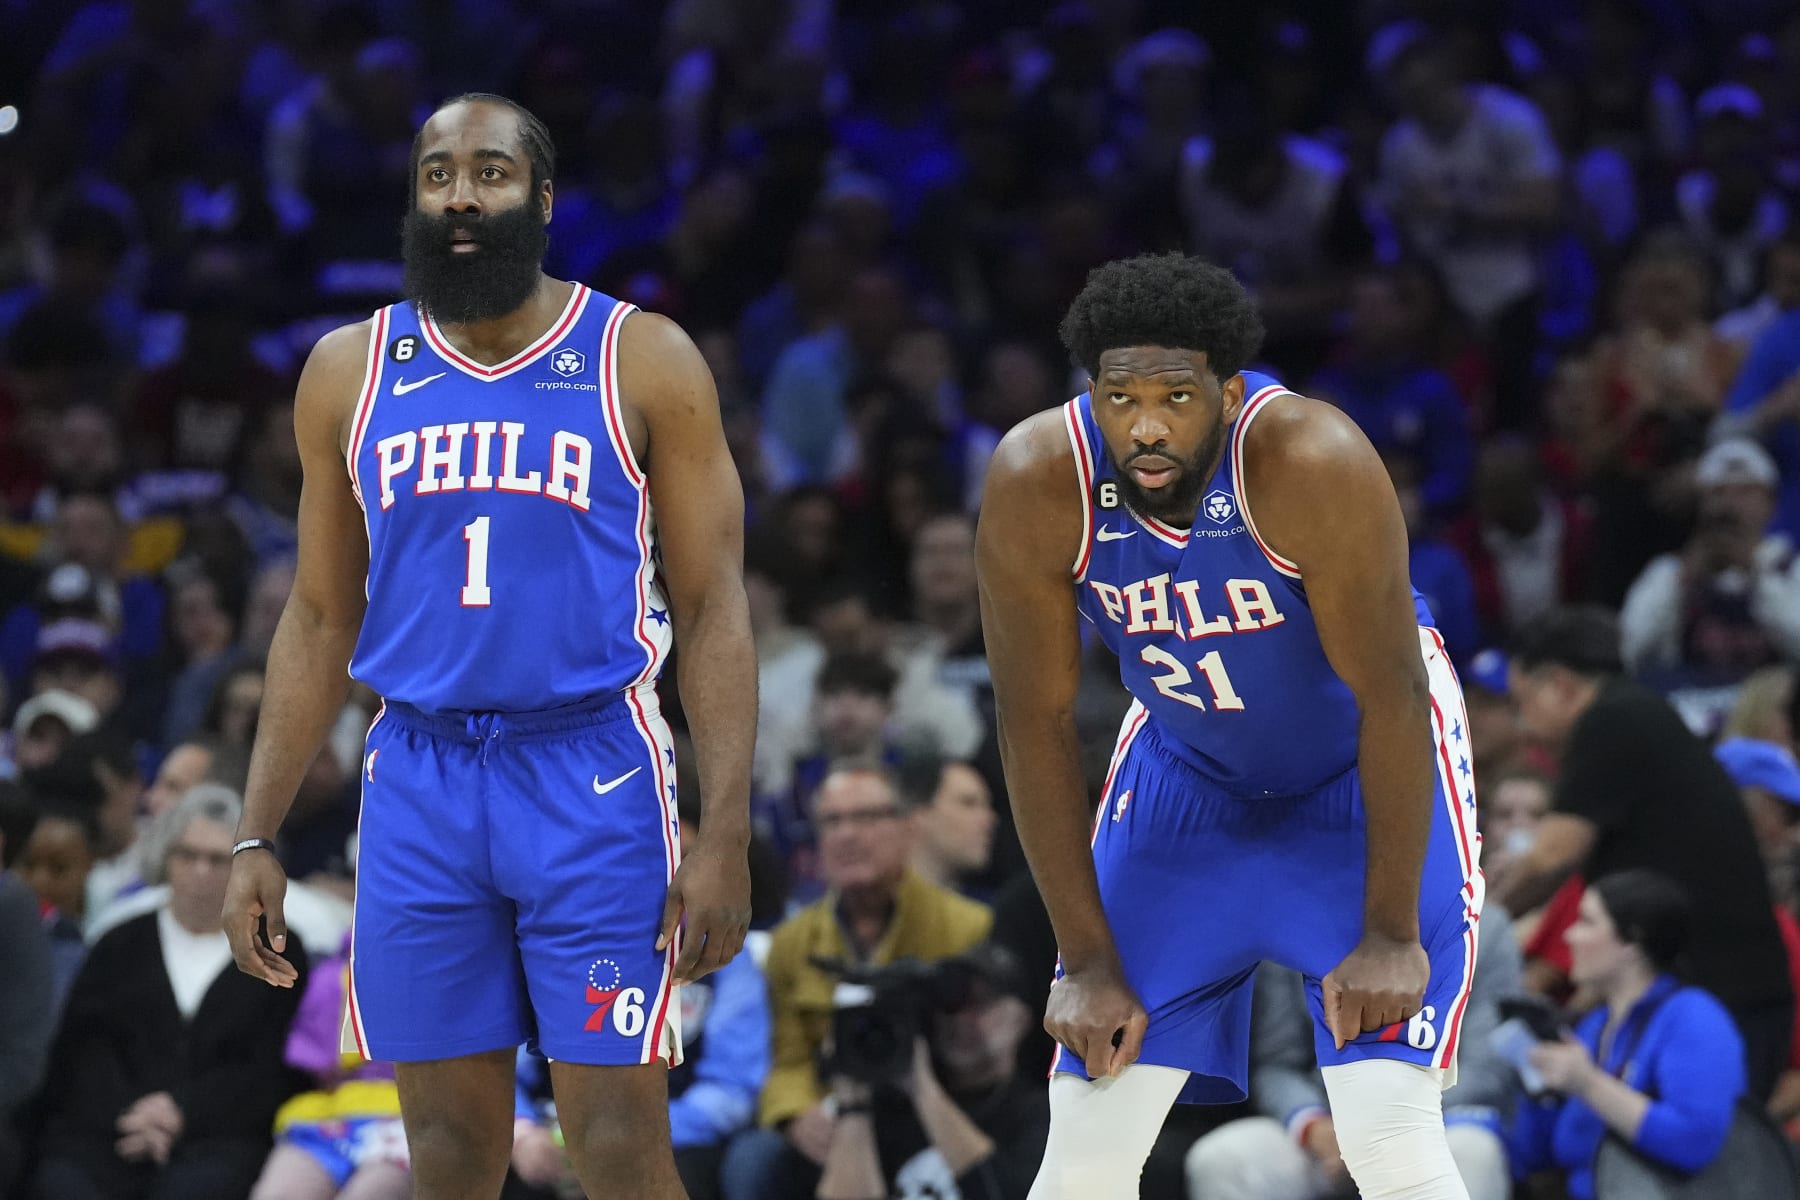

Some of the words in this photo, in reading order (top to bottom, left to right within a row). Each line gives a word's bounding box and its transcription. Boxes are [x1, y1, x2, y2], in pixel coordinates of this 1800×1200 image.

[396, 339, 414, 360] 6
[535, 381, 597, 391] crypto.com
[375, 421, 592, 512] PHILA
[1100, 483, 1118, 508] 6
[1195, 525, 1246, 538] crypto.co
[460, 516, 490, 607] 1
[1089, 573, 1285, 642] PHLA
[1140, 644, 1245, 711] 21
[584, 984, 645, 1037] 76
